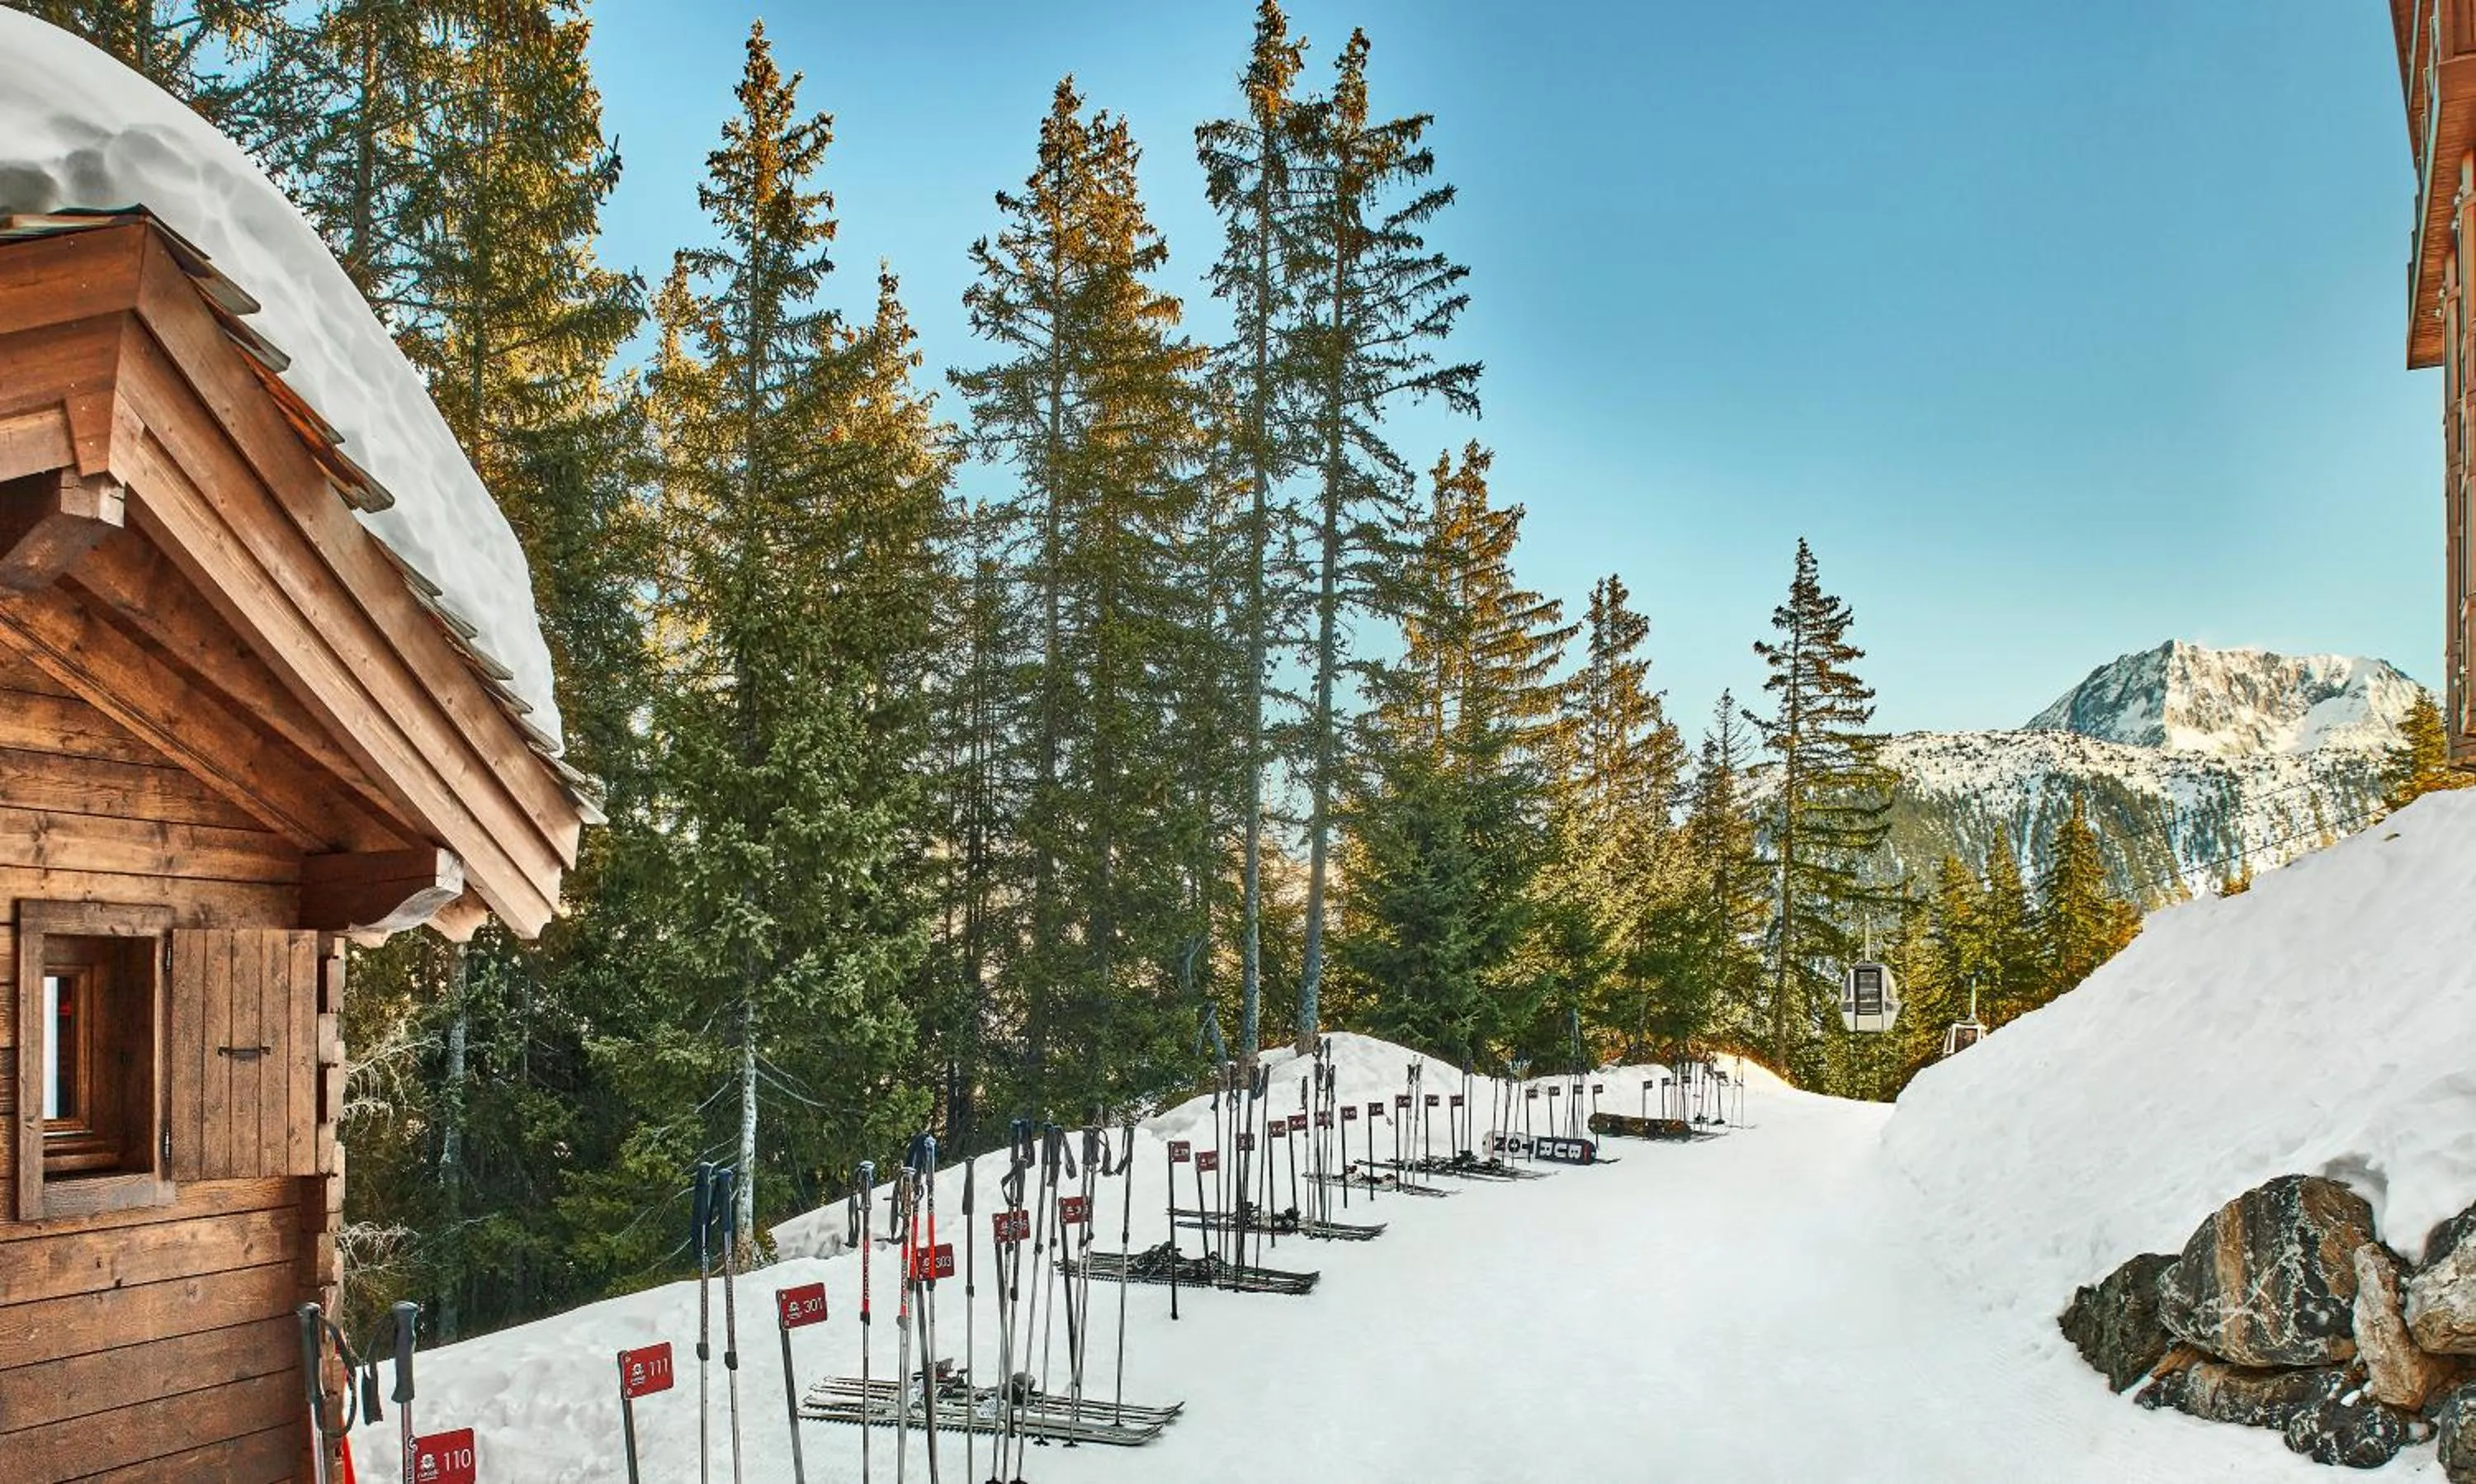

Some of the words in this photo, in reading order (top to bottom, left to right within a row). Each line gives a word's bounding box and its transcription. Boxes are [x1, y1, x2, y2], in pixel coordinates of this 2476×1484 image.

[1493, 1137, 1582, 1160] BURTON
[803, 1297, 823, 1313] 301
[649, 1357, 668, 1378] 111
[443, 1449, 471, 1472] 110
